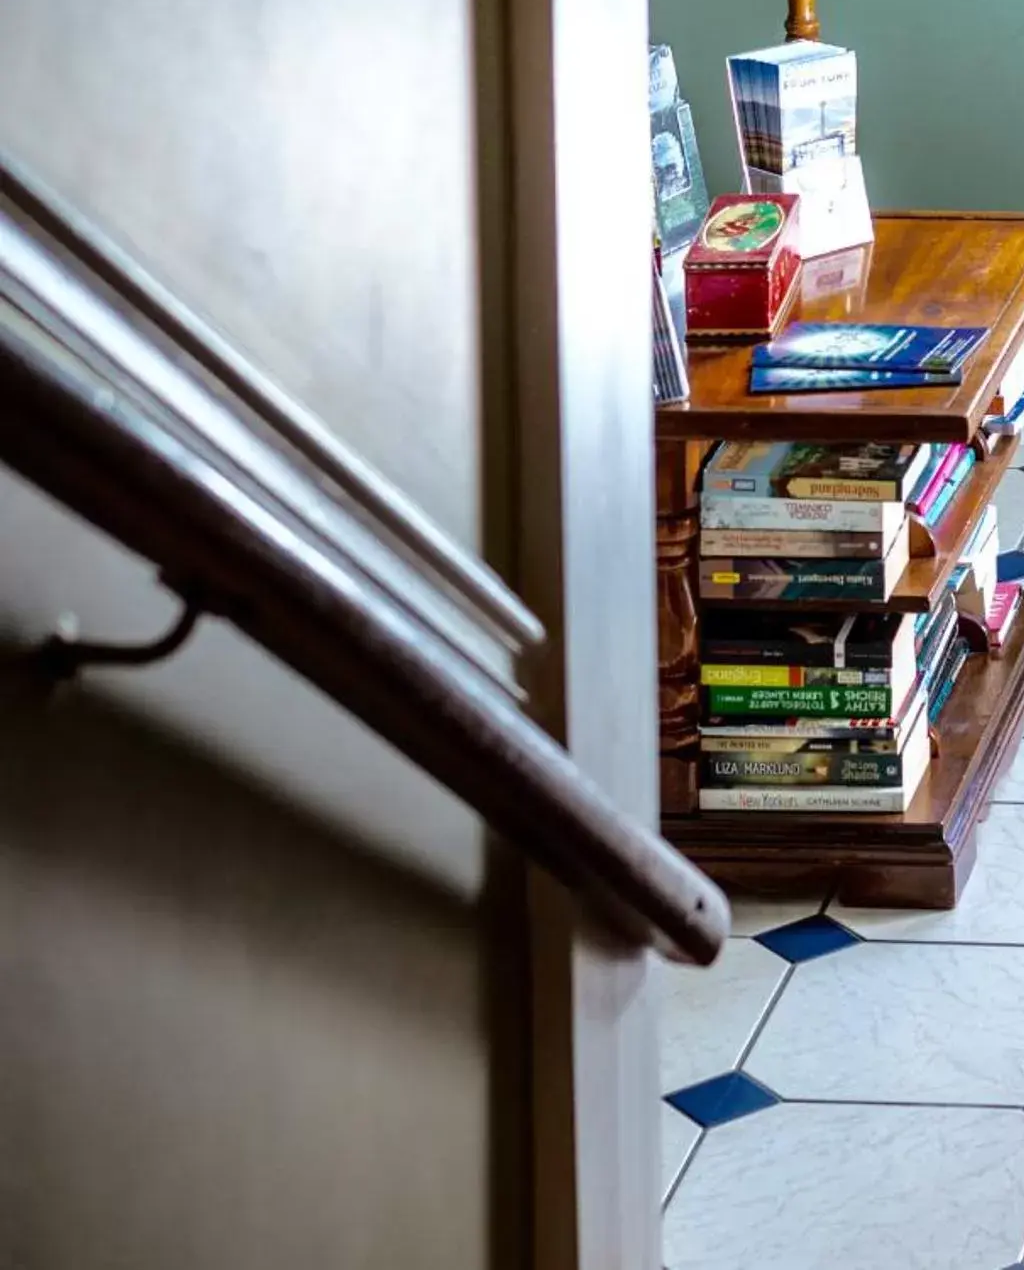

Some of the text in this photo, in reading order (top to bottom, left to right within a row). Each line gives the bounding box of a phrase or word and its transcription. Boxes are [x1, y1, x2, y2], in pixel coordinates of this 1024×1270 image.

[707, 667, 762, 684] England
[792, 690, 823, 701] LEBEN
[844, 690, 887, 702] REICHS
[844, 701, 887, 713] KATHY
[715, 761, 800, 777] LIZA MARKLUND
